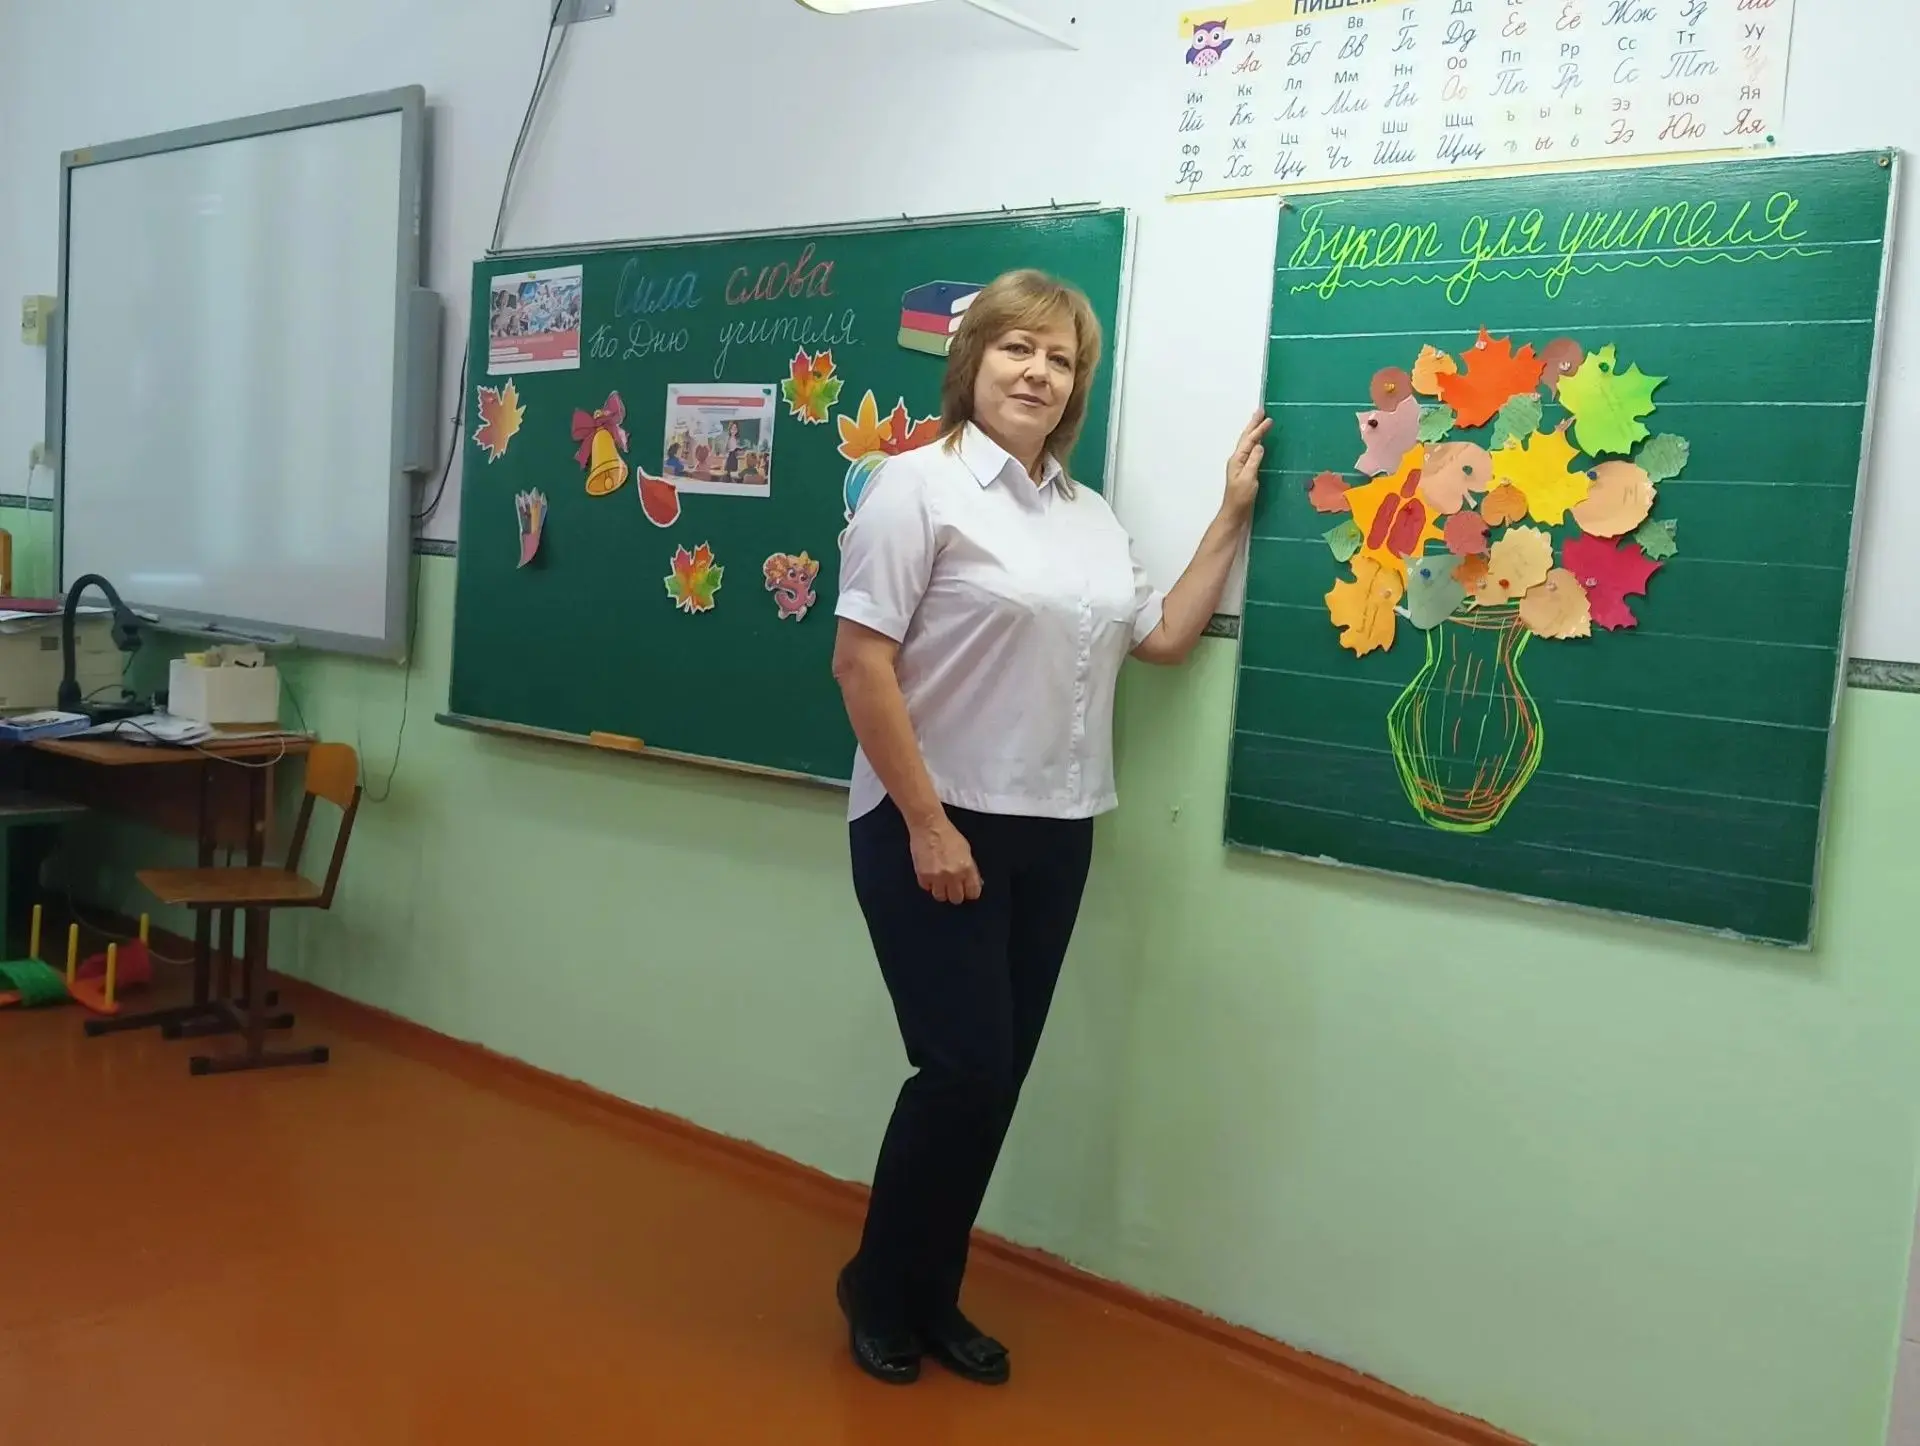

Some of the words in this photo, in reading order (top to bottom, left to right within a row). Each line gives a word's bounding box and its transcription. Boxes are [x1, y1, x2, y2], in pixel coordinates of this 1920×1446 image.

[1294, 0, 1377, 16] ПИШ
[1288, 199, 1443, 300] Букет
[1446, 208, 1547, 306] для
[1545, 192, 1808, 299] учителя
[614, 256, 703, 318] Сила
[623, 319, 689, 360] Дню
